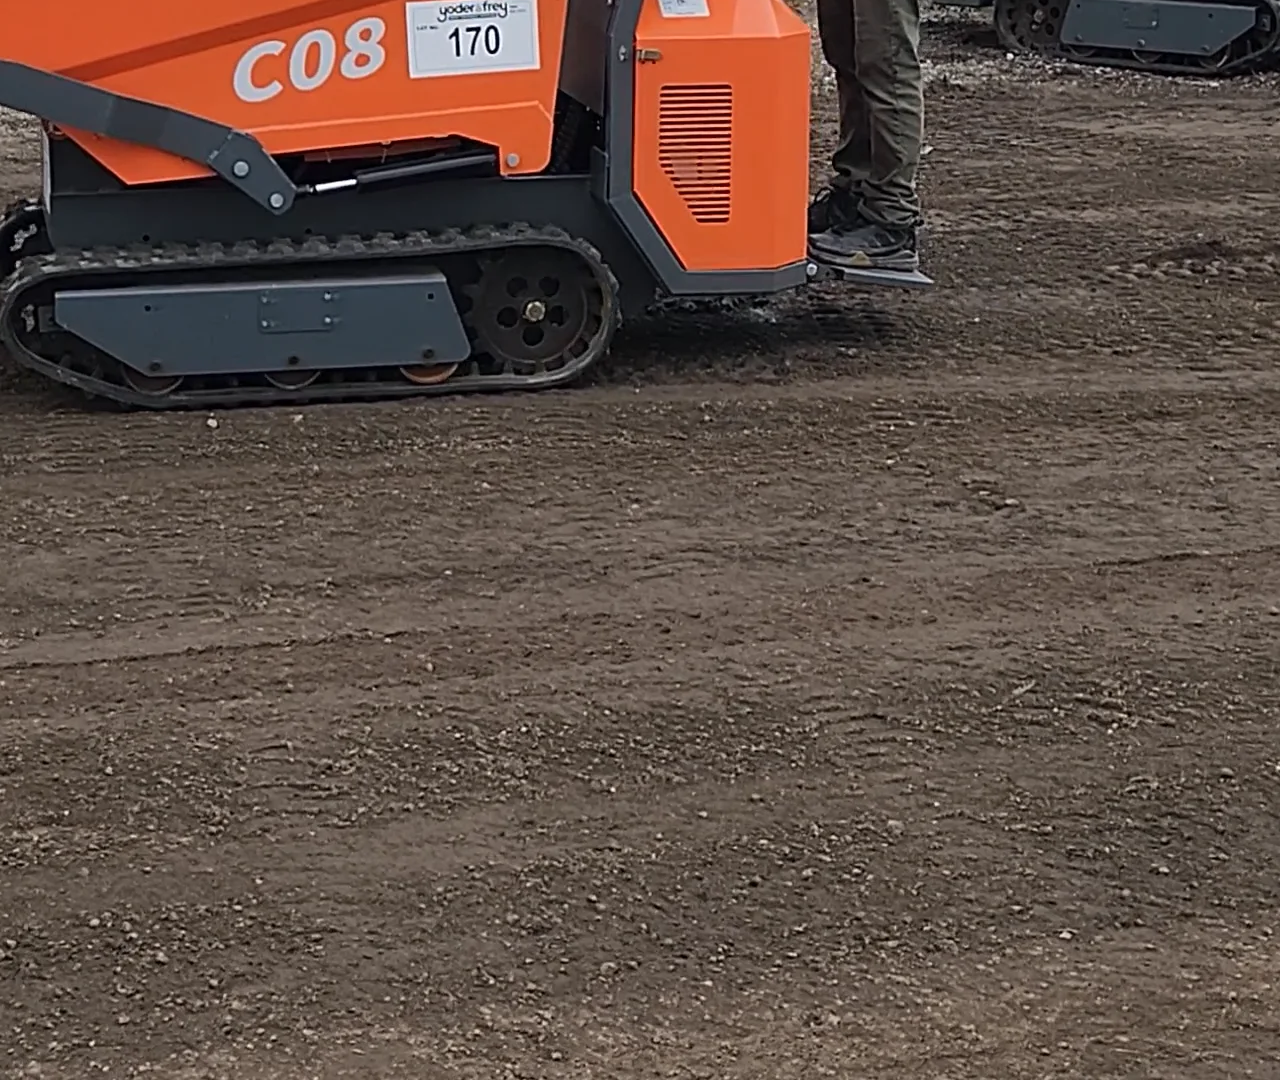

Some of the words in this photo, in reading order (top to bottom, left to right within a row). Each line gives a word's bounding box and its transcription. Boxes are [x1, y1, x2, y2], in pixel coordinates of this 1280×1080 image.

[482, 0, 508, 18] frey
[448, 24, 500, 57] 170
[233, 16, 386, 103] C08
